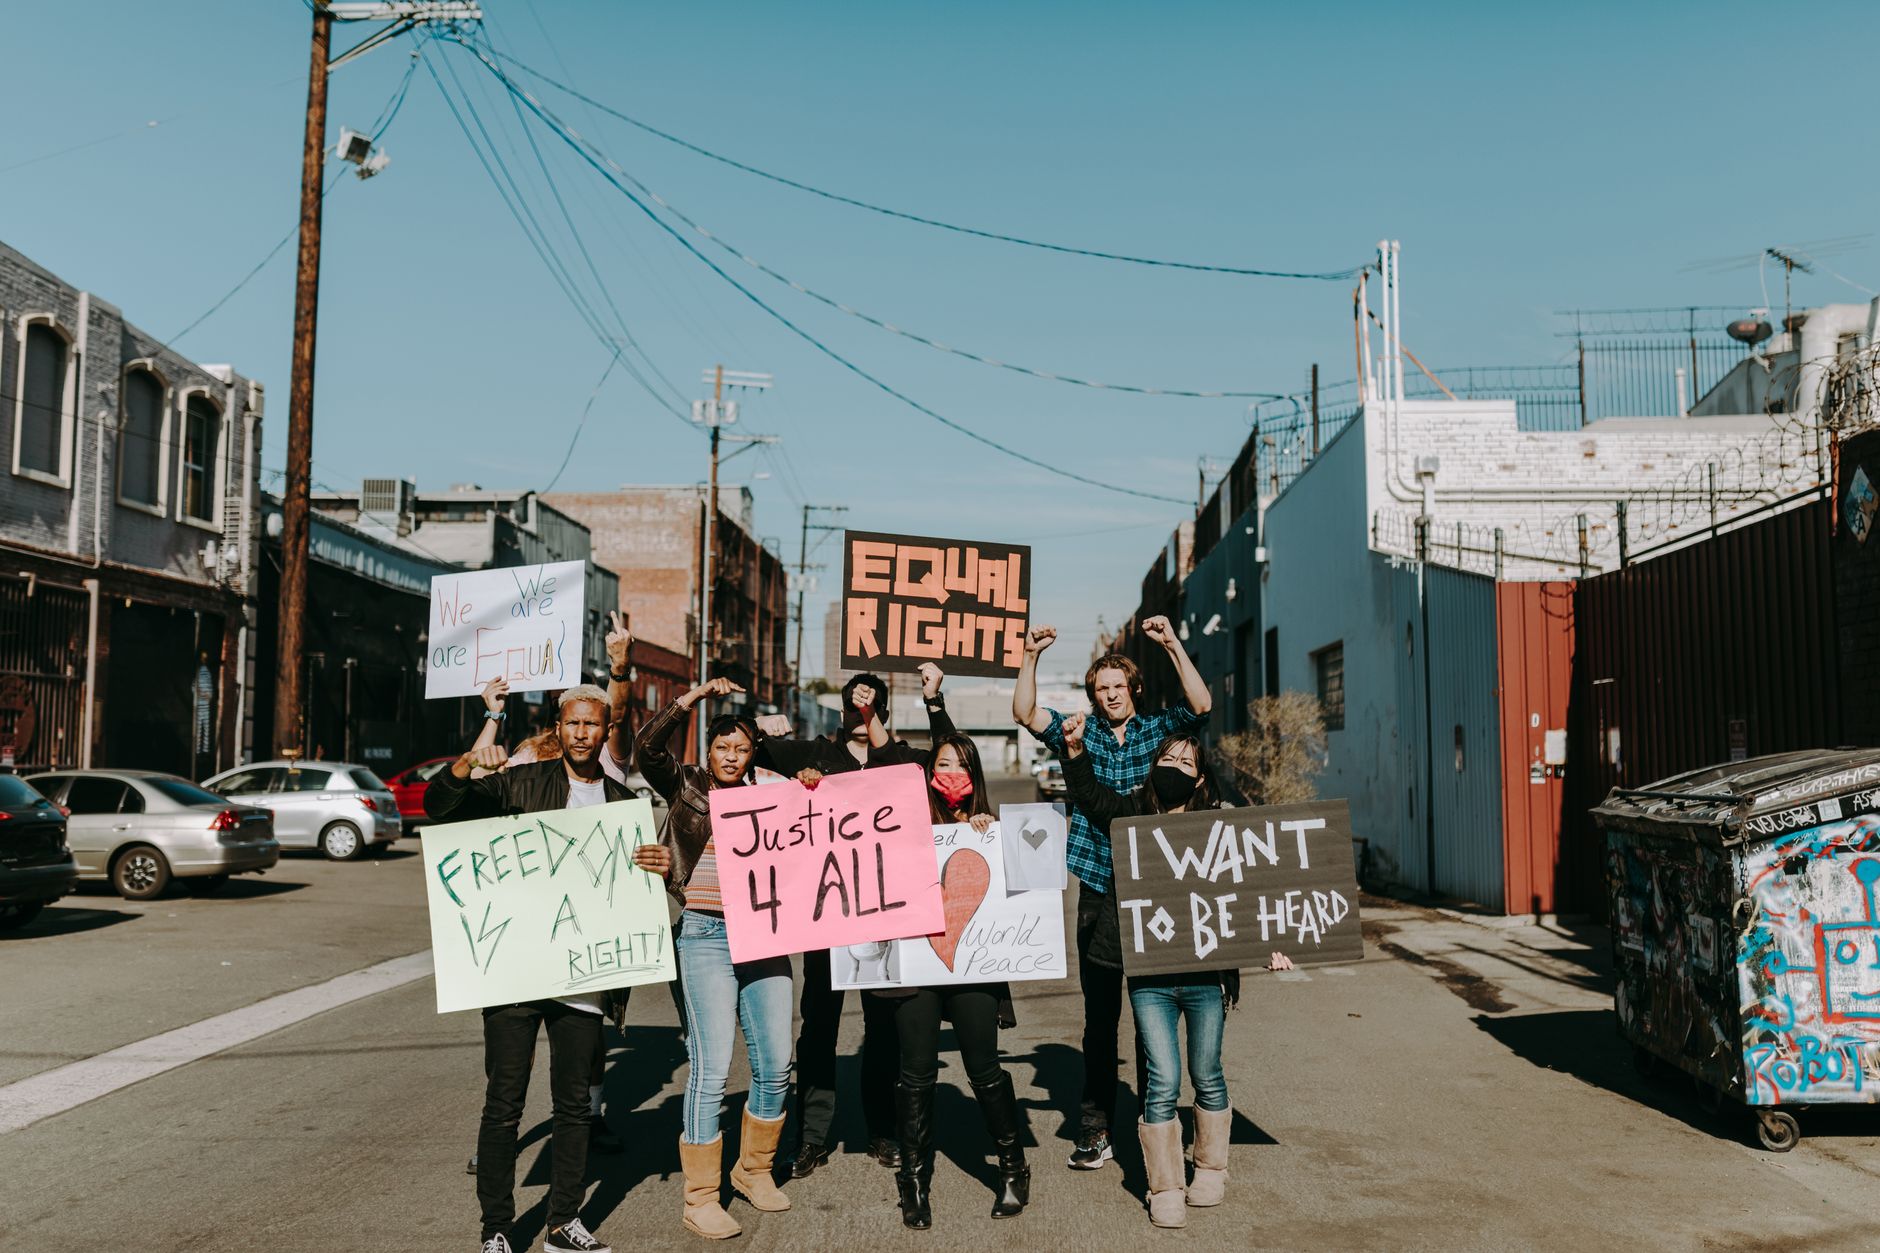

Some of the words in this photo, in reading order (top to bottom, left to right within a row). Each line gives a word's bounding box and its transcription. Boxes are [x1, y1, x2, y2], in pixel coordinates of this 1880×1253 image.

[438, 581, 473, 627] We
[512, 564, 557, 599] We
[851, 540, 1027, 613] EQUAL
[511, 597, 554, 618] are
[846, 597, 1026, 669] RIGHTS
[432, 643, 467, 669] are
[720, 799, 901, 857] Justice
[934, 829, 958, 846] ed
[1128, 826, 1143, 880] I
[1152, 818, 1326, 884] WANT
[437, 818, 652, 908] FREEDOM
[748, 865, 783, 935] 4
[812, 842, 907, 922] ALL
[460, 901, 513, 976] IS
[550, 893, 583, 943] A
[568, 924, 665, 980] RIGHT!
[960, 913, 1044, 947] World
[1120, 899, 1175, 953] TO
[1190, 891, 1237, 960] BE
[1256, 889, 1349, 949] HEARD
[963, 946, 1059, 976] Peace
[1743, 1035, 1866, 1105] ROBOT
